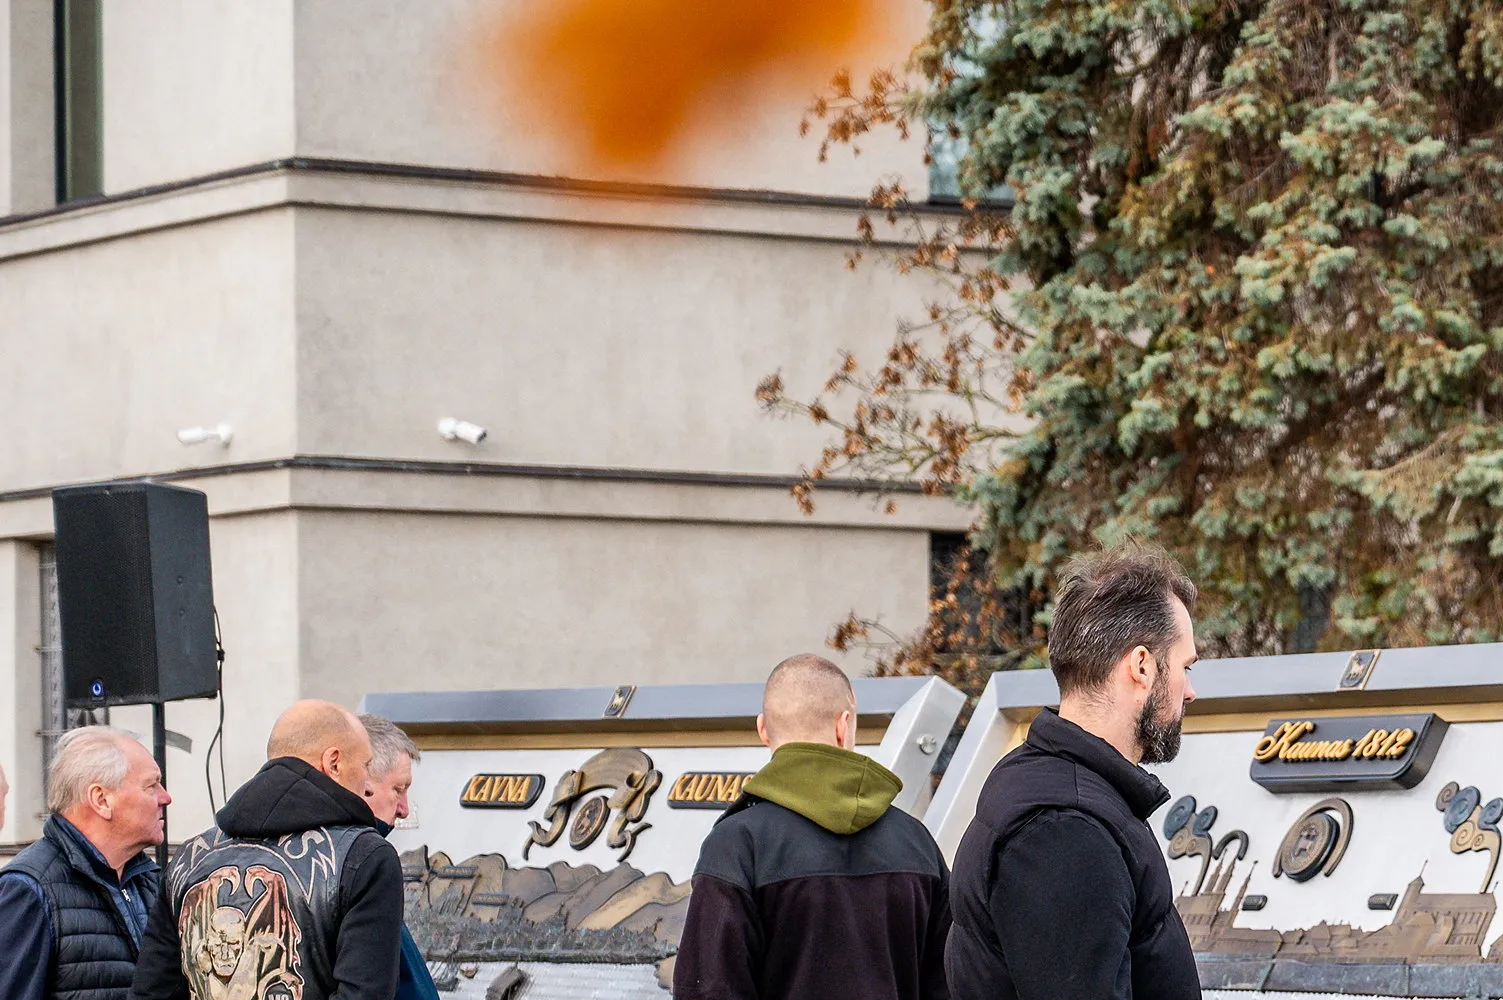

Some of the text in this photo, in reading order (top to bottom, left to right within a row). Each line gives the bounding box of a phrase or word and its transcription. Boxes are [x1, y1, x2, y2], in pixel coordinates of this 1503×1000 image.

[1254, 721, 1414, 761] Kaunas 1812
[464, 776, 532, 802] KAVNA
